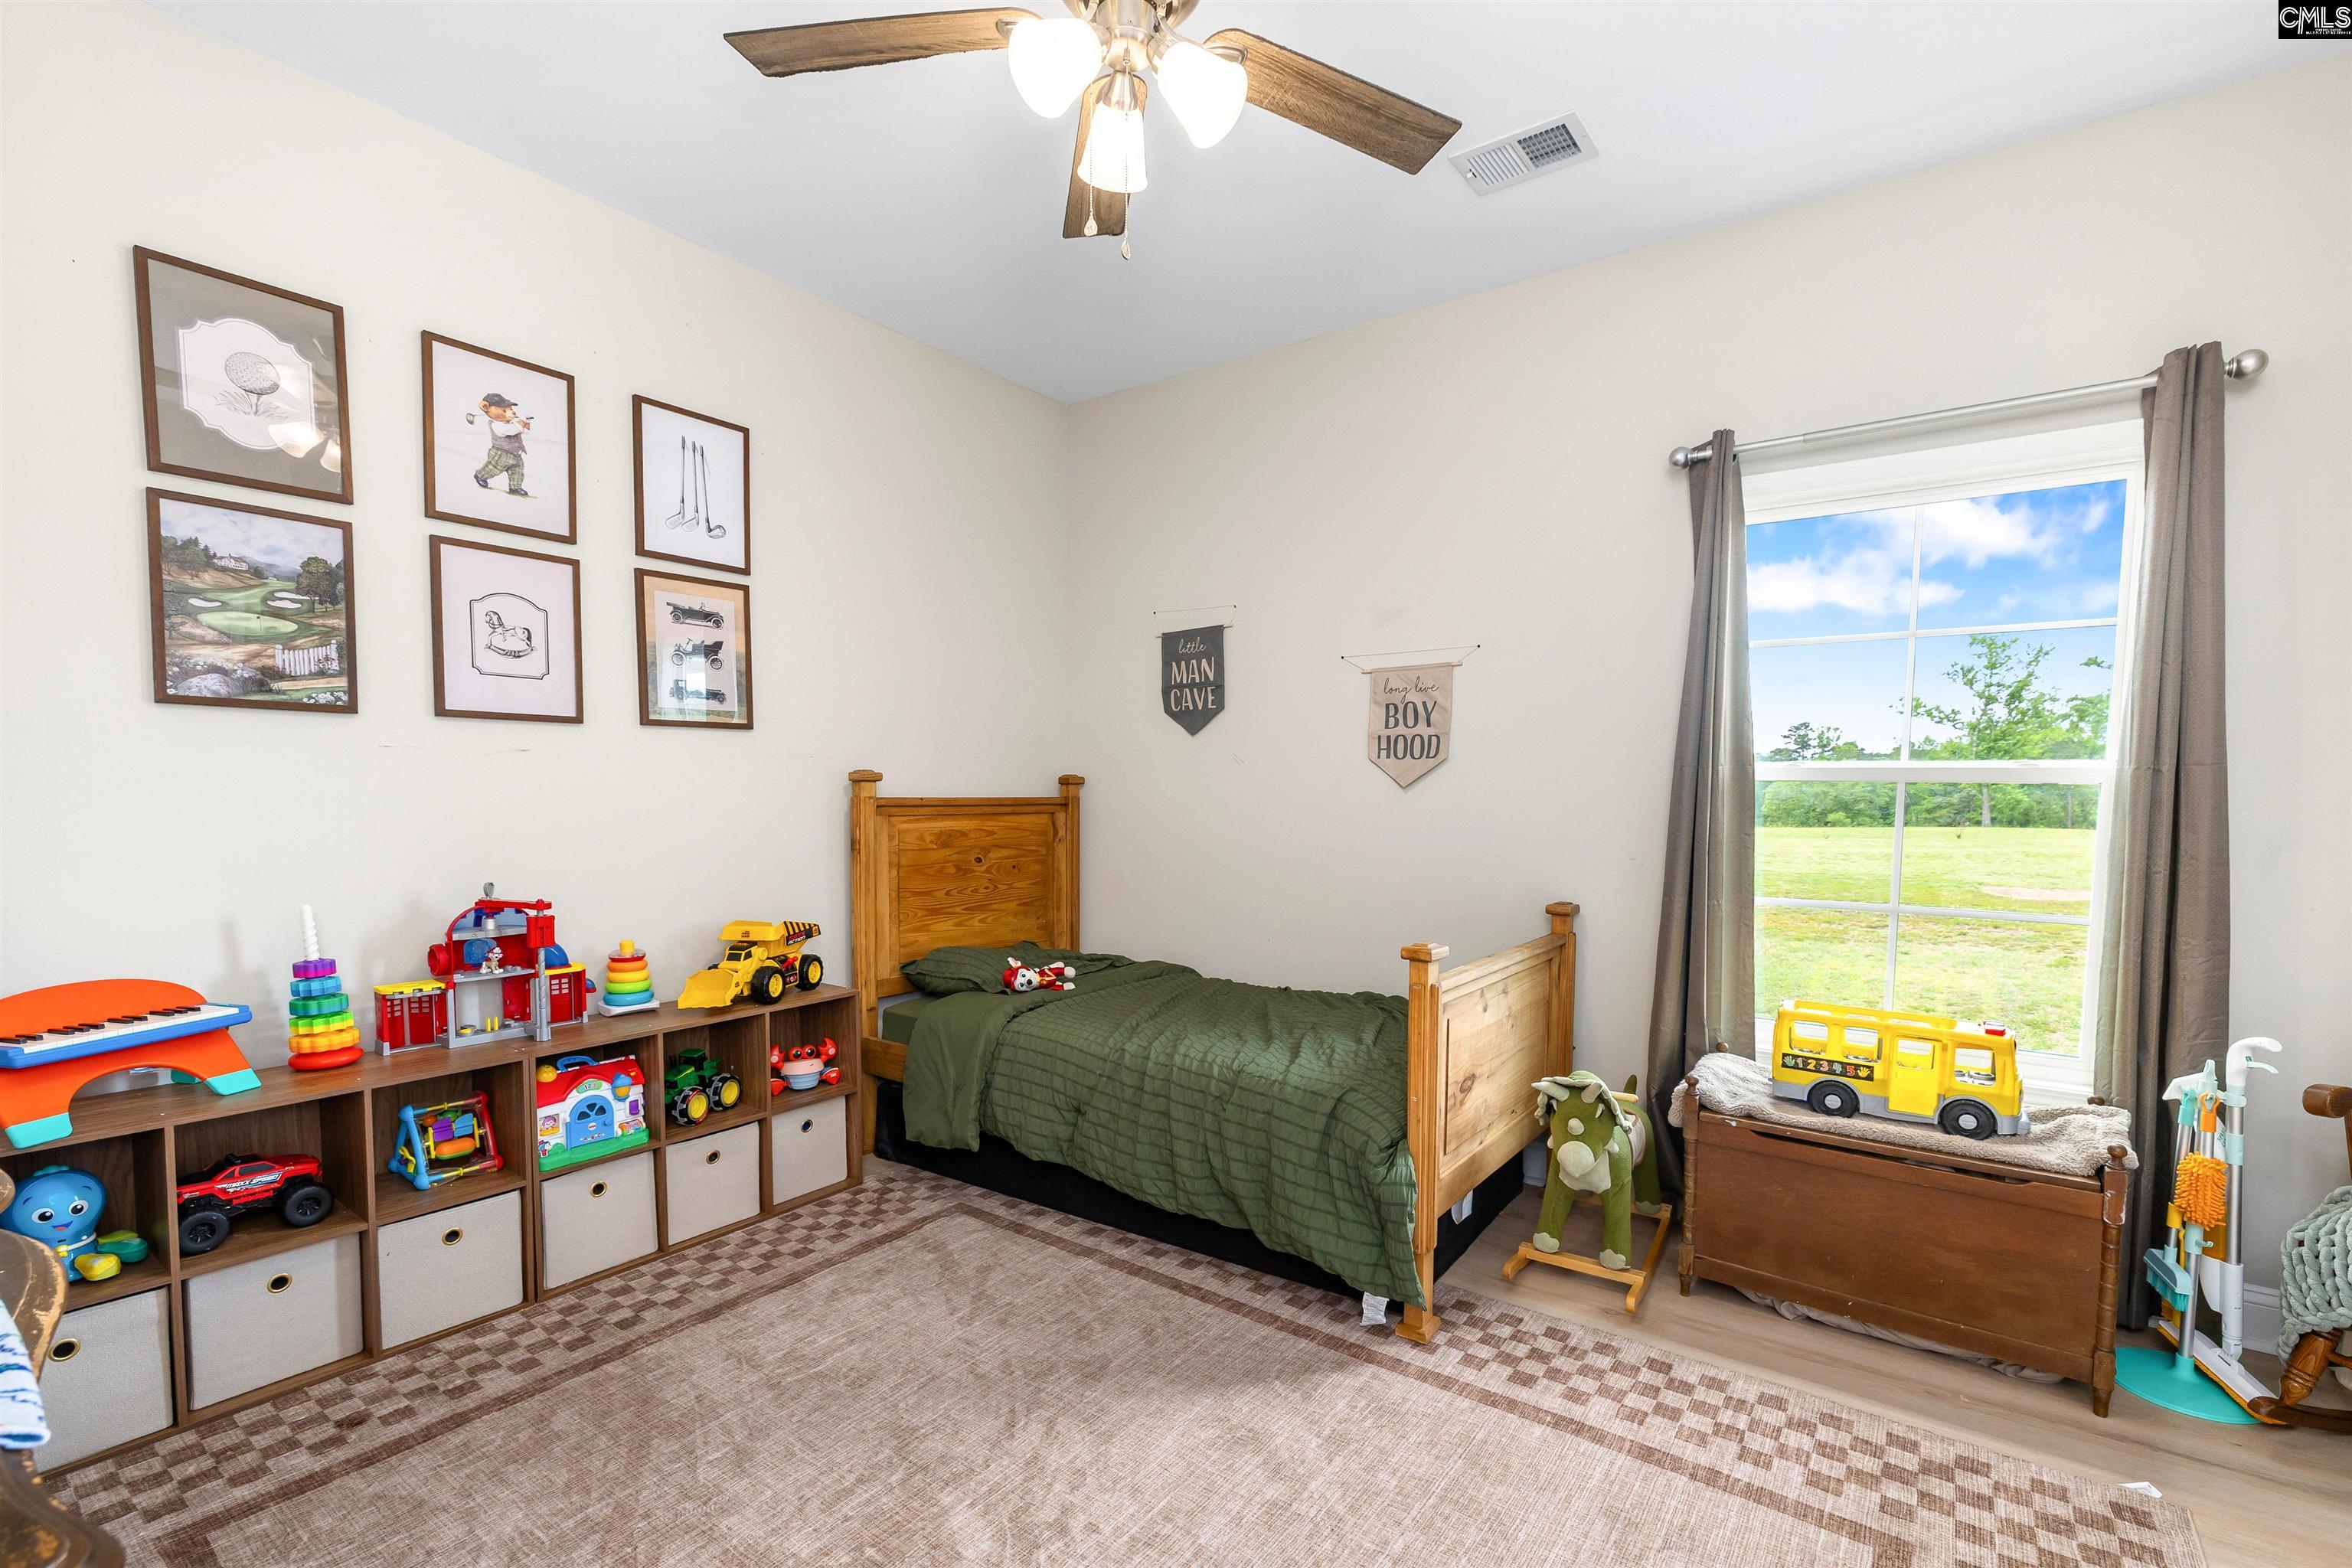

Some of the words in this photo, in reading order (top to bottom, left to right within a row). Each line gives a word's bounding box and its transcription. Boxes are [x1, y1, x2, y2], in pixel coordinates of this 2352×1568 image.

[1178, 637, 1207, 654] little
[1171, 656, 1214, 684] MAN
[1170, 686, 1217, 711] CAVE
[1383, 678, 1413, 704] long
[1415, 676, 1439, 693] live
[1384, 701, 1437, 729] BOY
[1377, 734, 1441, 760] HOOD
[1796, 1057, 1803, 1067] 1
[1807, 1060, 1816, 1070] 2
[1820, 1061, 1828, 1071] 3
[1833, 1063, 1842, 1073] 4
[1847, 1066, 1855, 1076] 5
